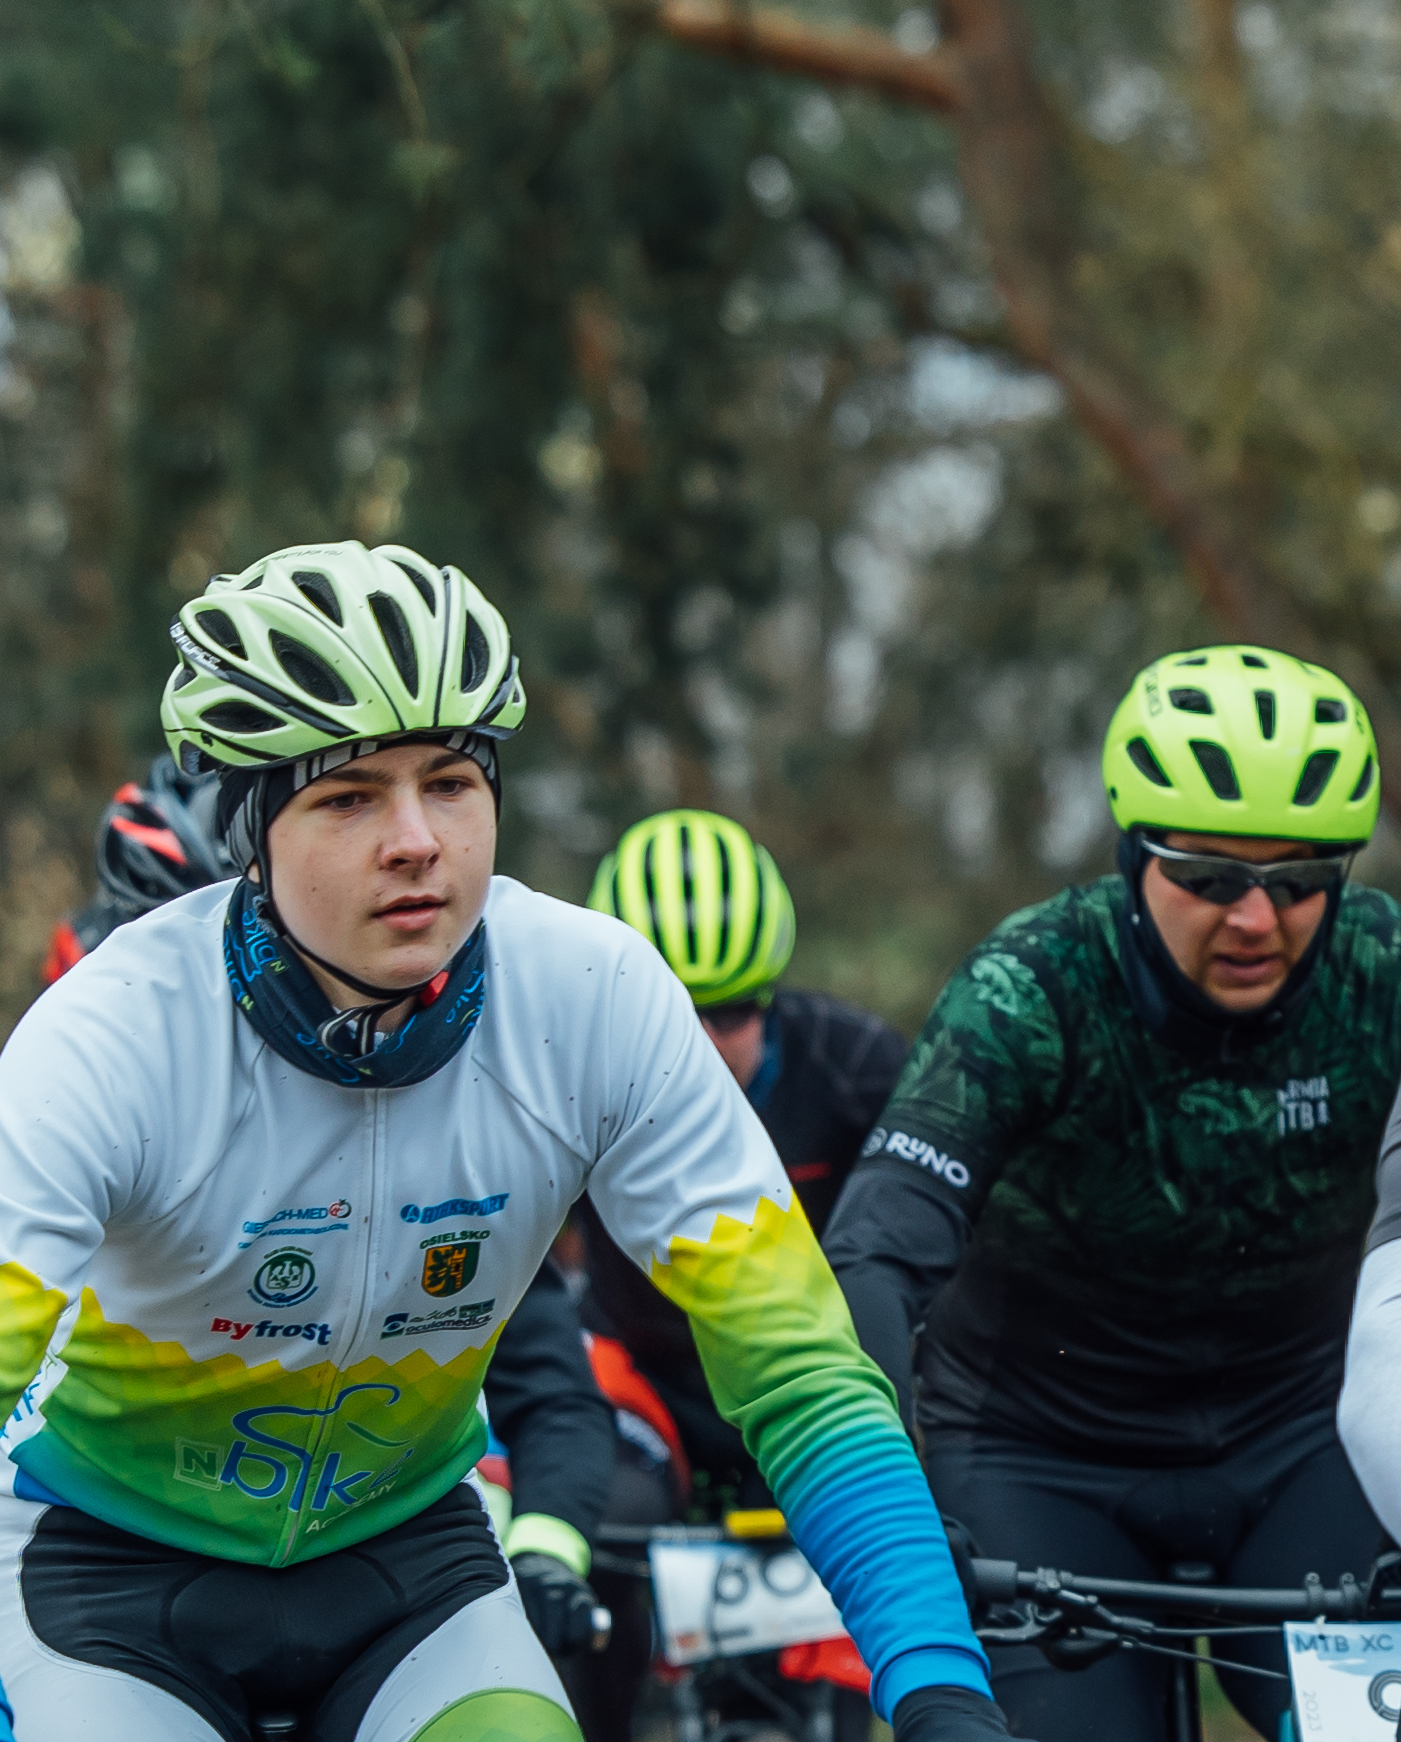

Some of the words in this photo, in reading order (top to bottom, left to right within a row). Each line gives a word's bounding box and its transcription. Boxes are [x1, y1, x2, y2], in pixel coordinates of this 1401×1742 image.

[420, 1230, 490, 1249] OSIELSKO
[210, 1317, 332, 1345] Byfrost
[1294, 1634, 1348, 1652] MTB
[1361, 1634, 1394, 1651] XC
